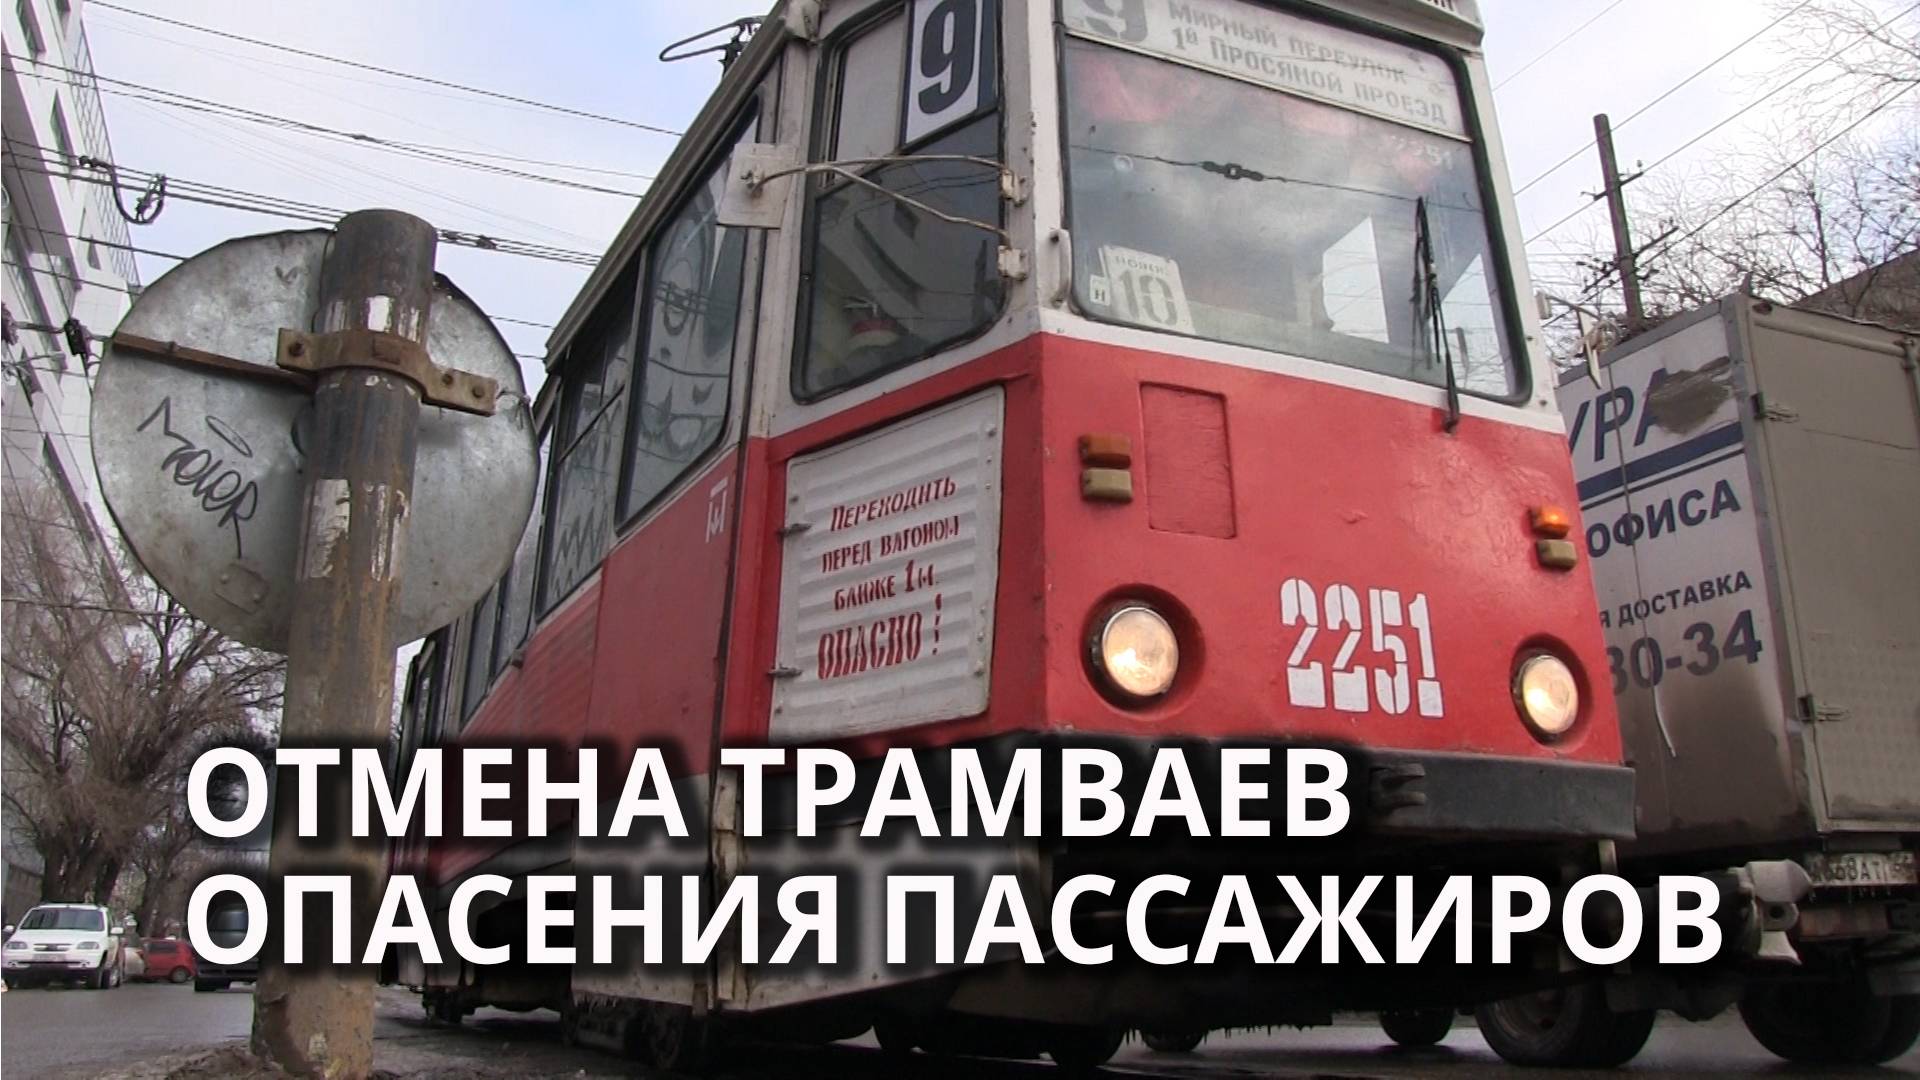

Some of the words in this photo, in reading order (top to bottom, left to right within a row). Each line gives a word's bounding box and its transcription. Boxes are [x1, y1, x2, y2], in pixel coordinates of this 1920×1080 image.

[918, 0, 977, 114] 9
[1209, 36, 1342, 93] ПРОСЯНОЙ
[1354, 81, 1447, 125] ПРОЕЗД
[1118, 269, 1178, 326] 10
[1586, 479, 1741, 558] ОФИСА
[1618, 571, 1752, 628] ДОСТАВКА
[1280, 577, 1444, 719] 2251
